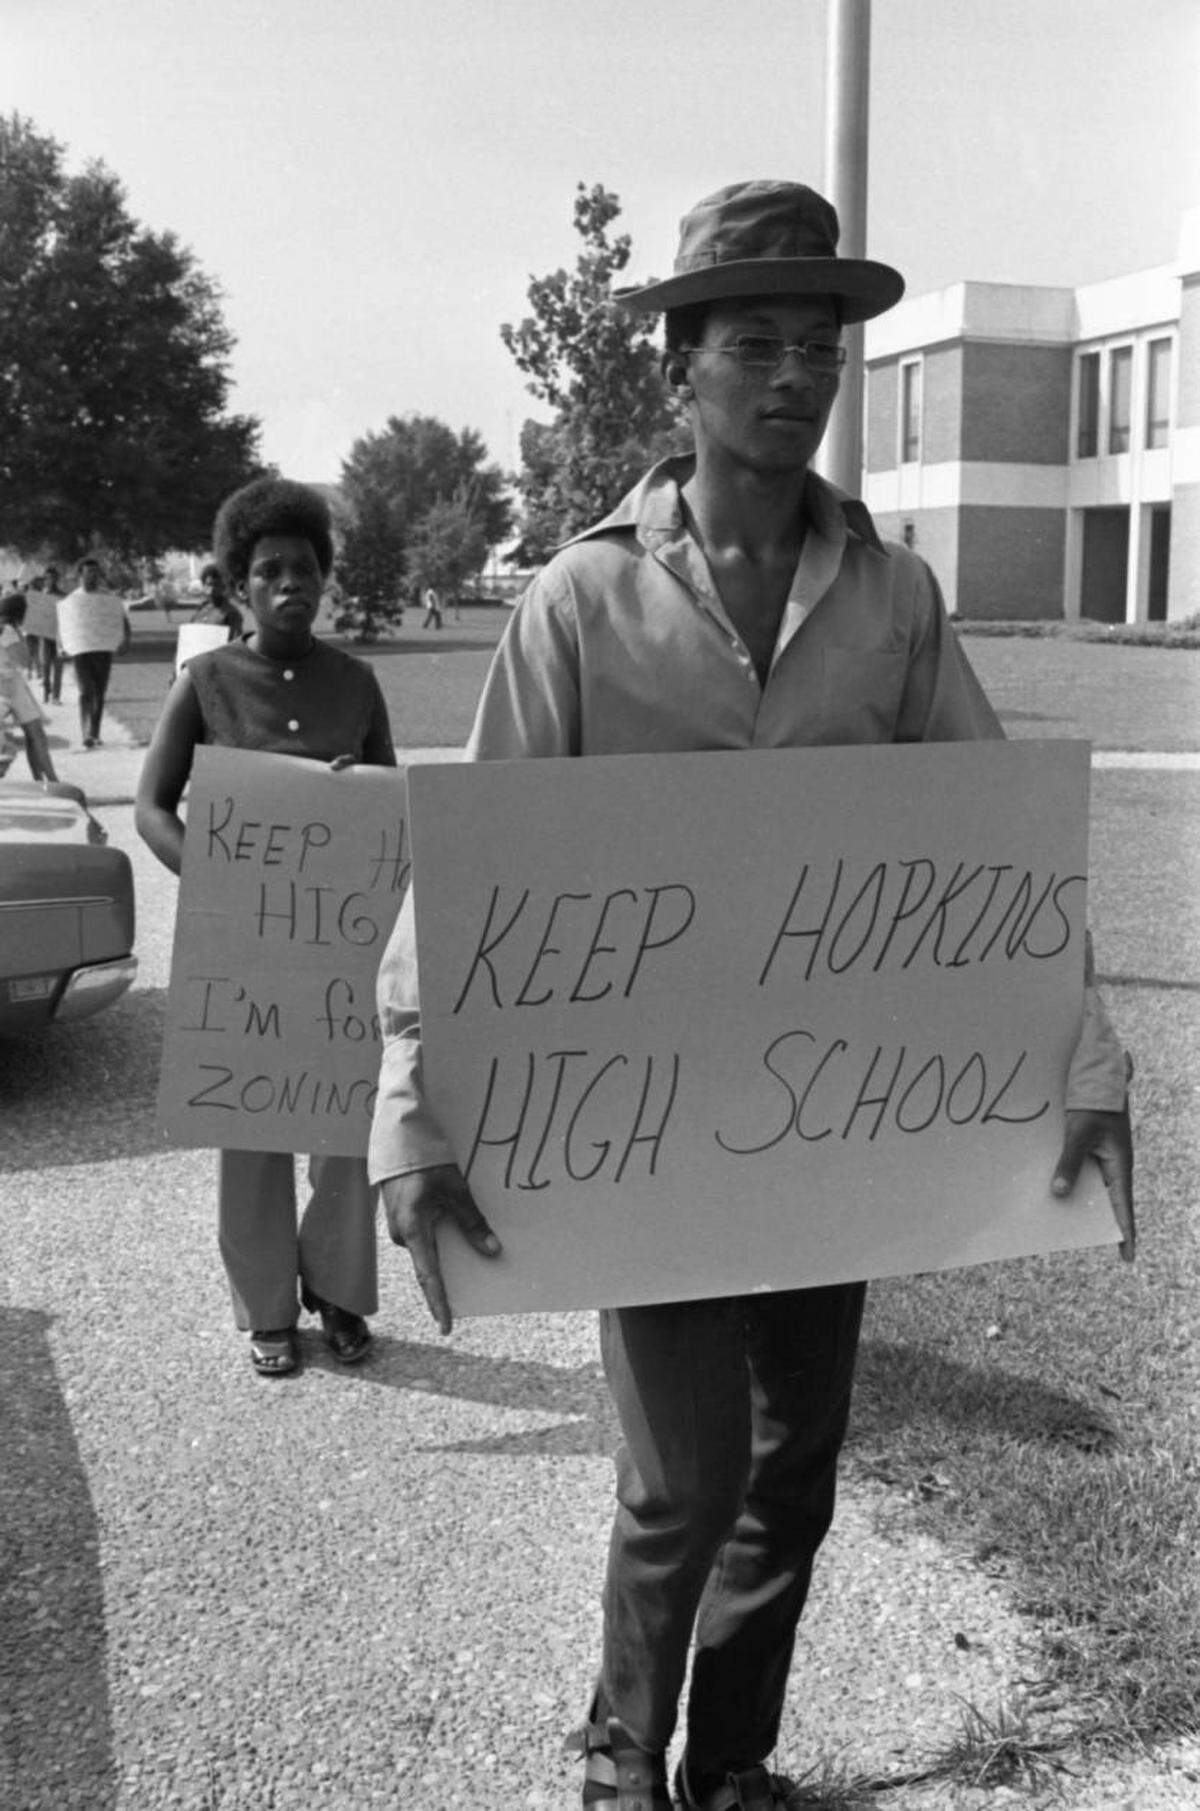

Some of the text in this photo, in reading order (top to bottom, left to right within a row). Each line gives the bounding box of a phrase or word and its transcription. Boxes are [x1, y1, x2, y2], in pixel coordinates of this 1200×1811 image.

[208, 798, 331, 873] KEEP
[453, 858, 1088, 1014] KEEP HOPKINS
[463, 1030, 1050, 1189] HIGH SCHOOL
